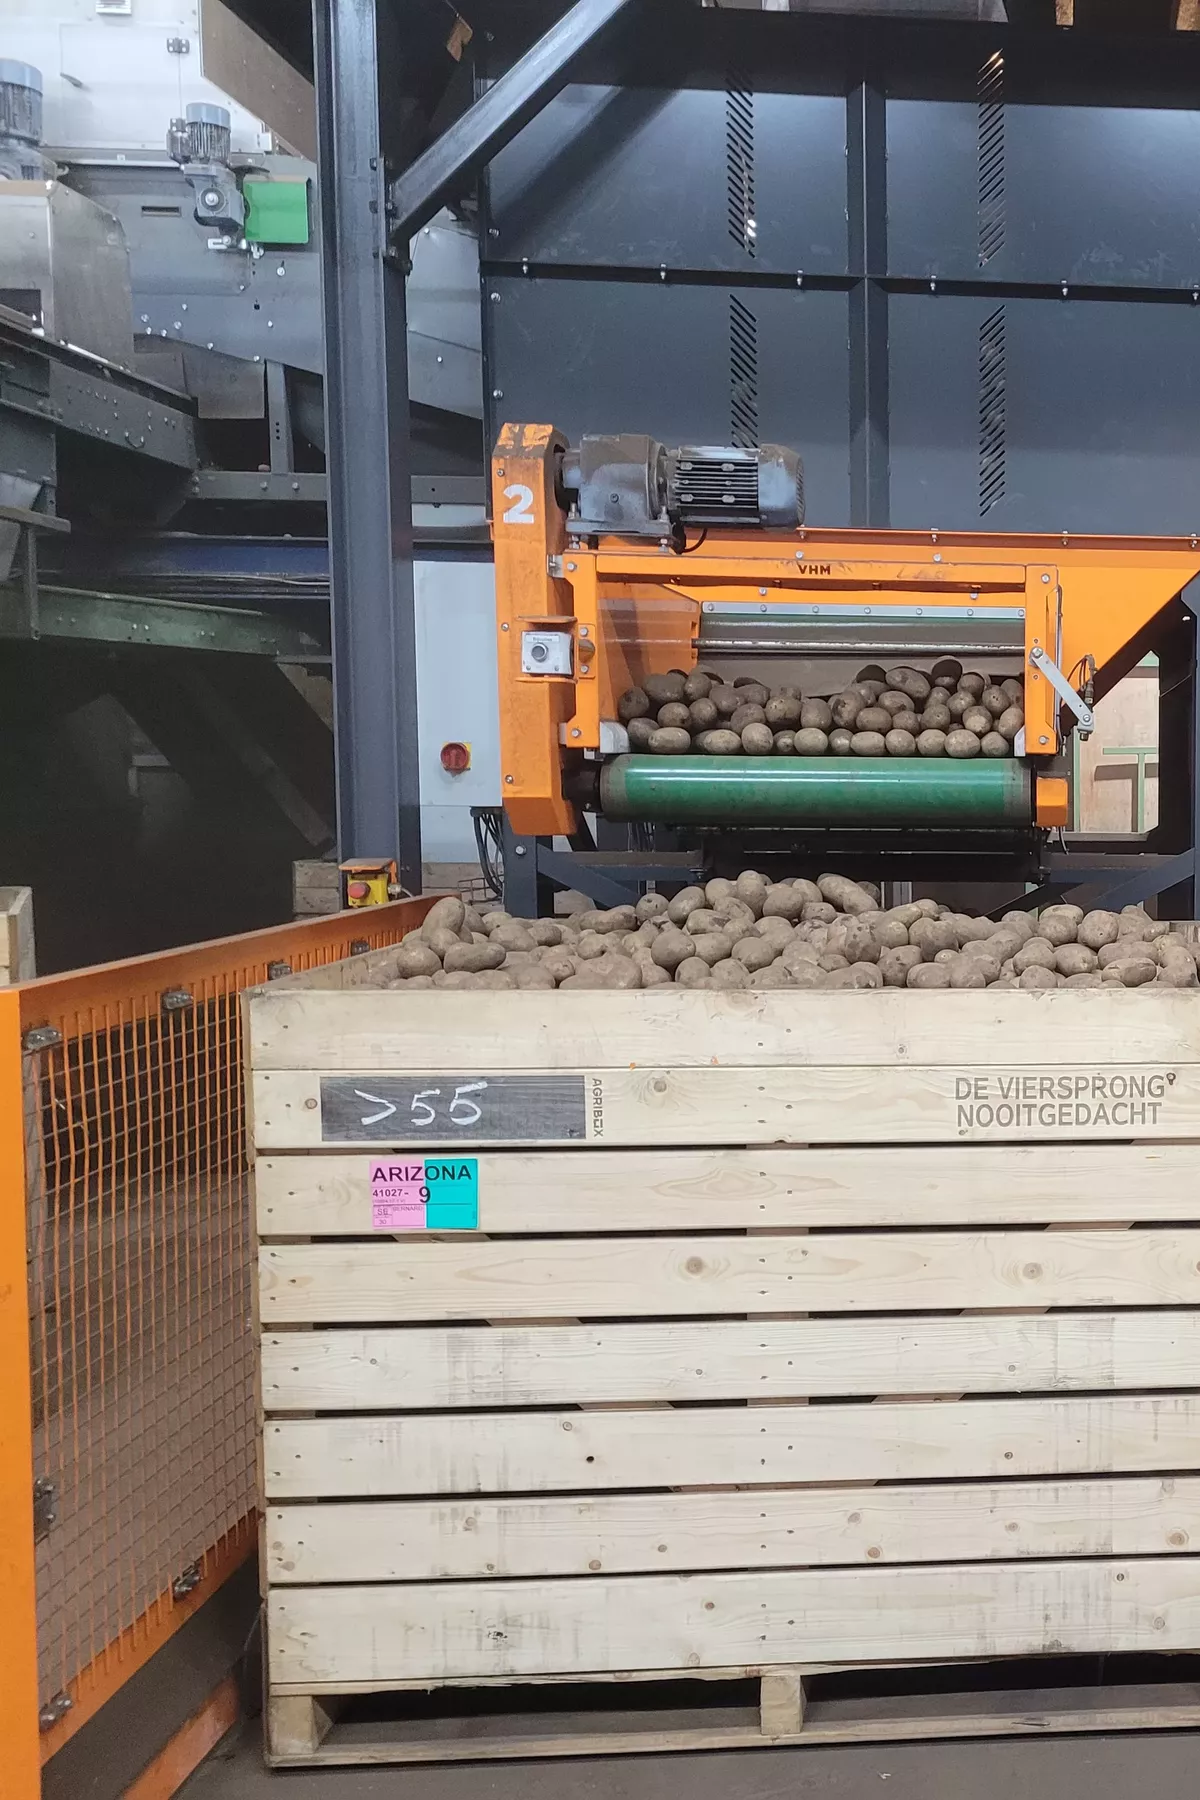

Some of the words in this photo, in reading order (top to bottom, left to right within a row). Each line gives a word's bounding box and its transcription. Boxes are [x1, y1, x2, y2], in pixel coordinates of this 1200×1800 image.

[503, 484, 534, 523] 2
[797, 564, 831, 575] VHM
[955, 1077, 989, 1101] DE
[997, 1074, 1166, 1100] VIERSPRONG
[592, 1078, 604, 1137] AGRIBOX
[957, 1102, 1162, 1127] NOOITGEDACHT
[372, 1165, 472, 1182] ARIZONA
[419, 1186, 431, 1203] 9
